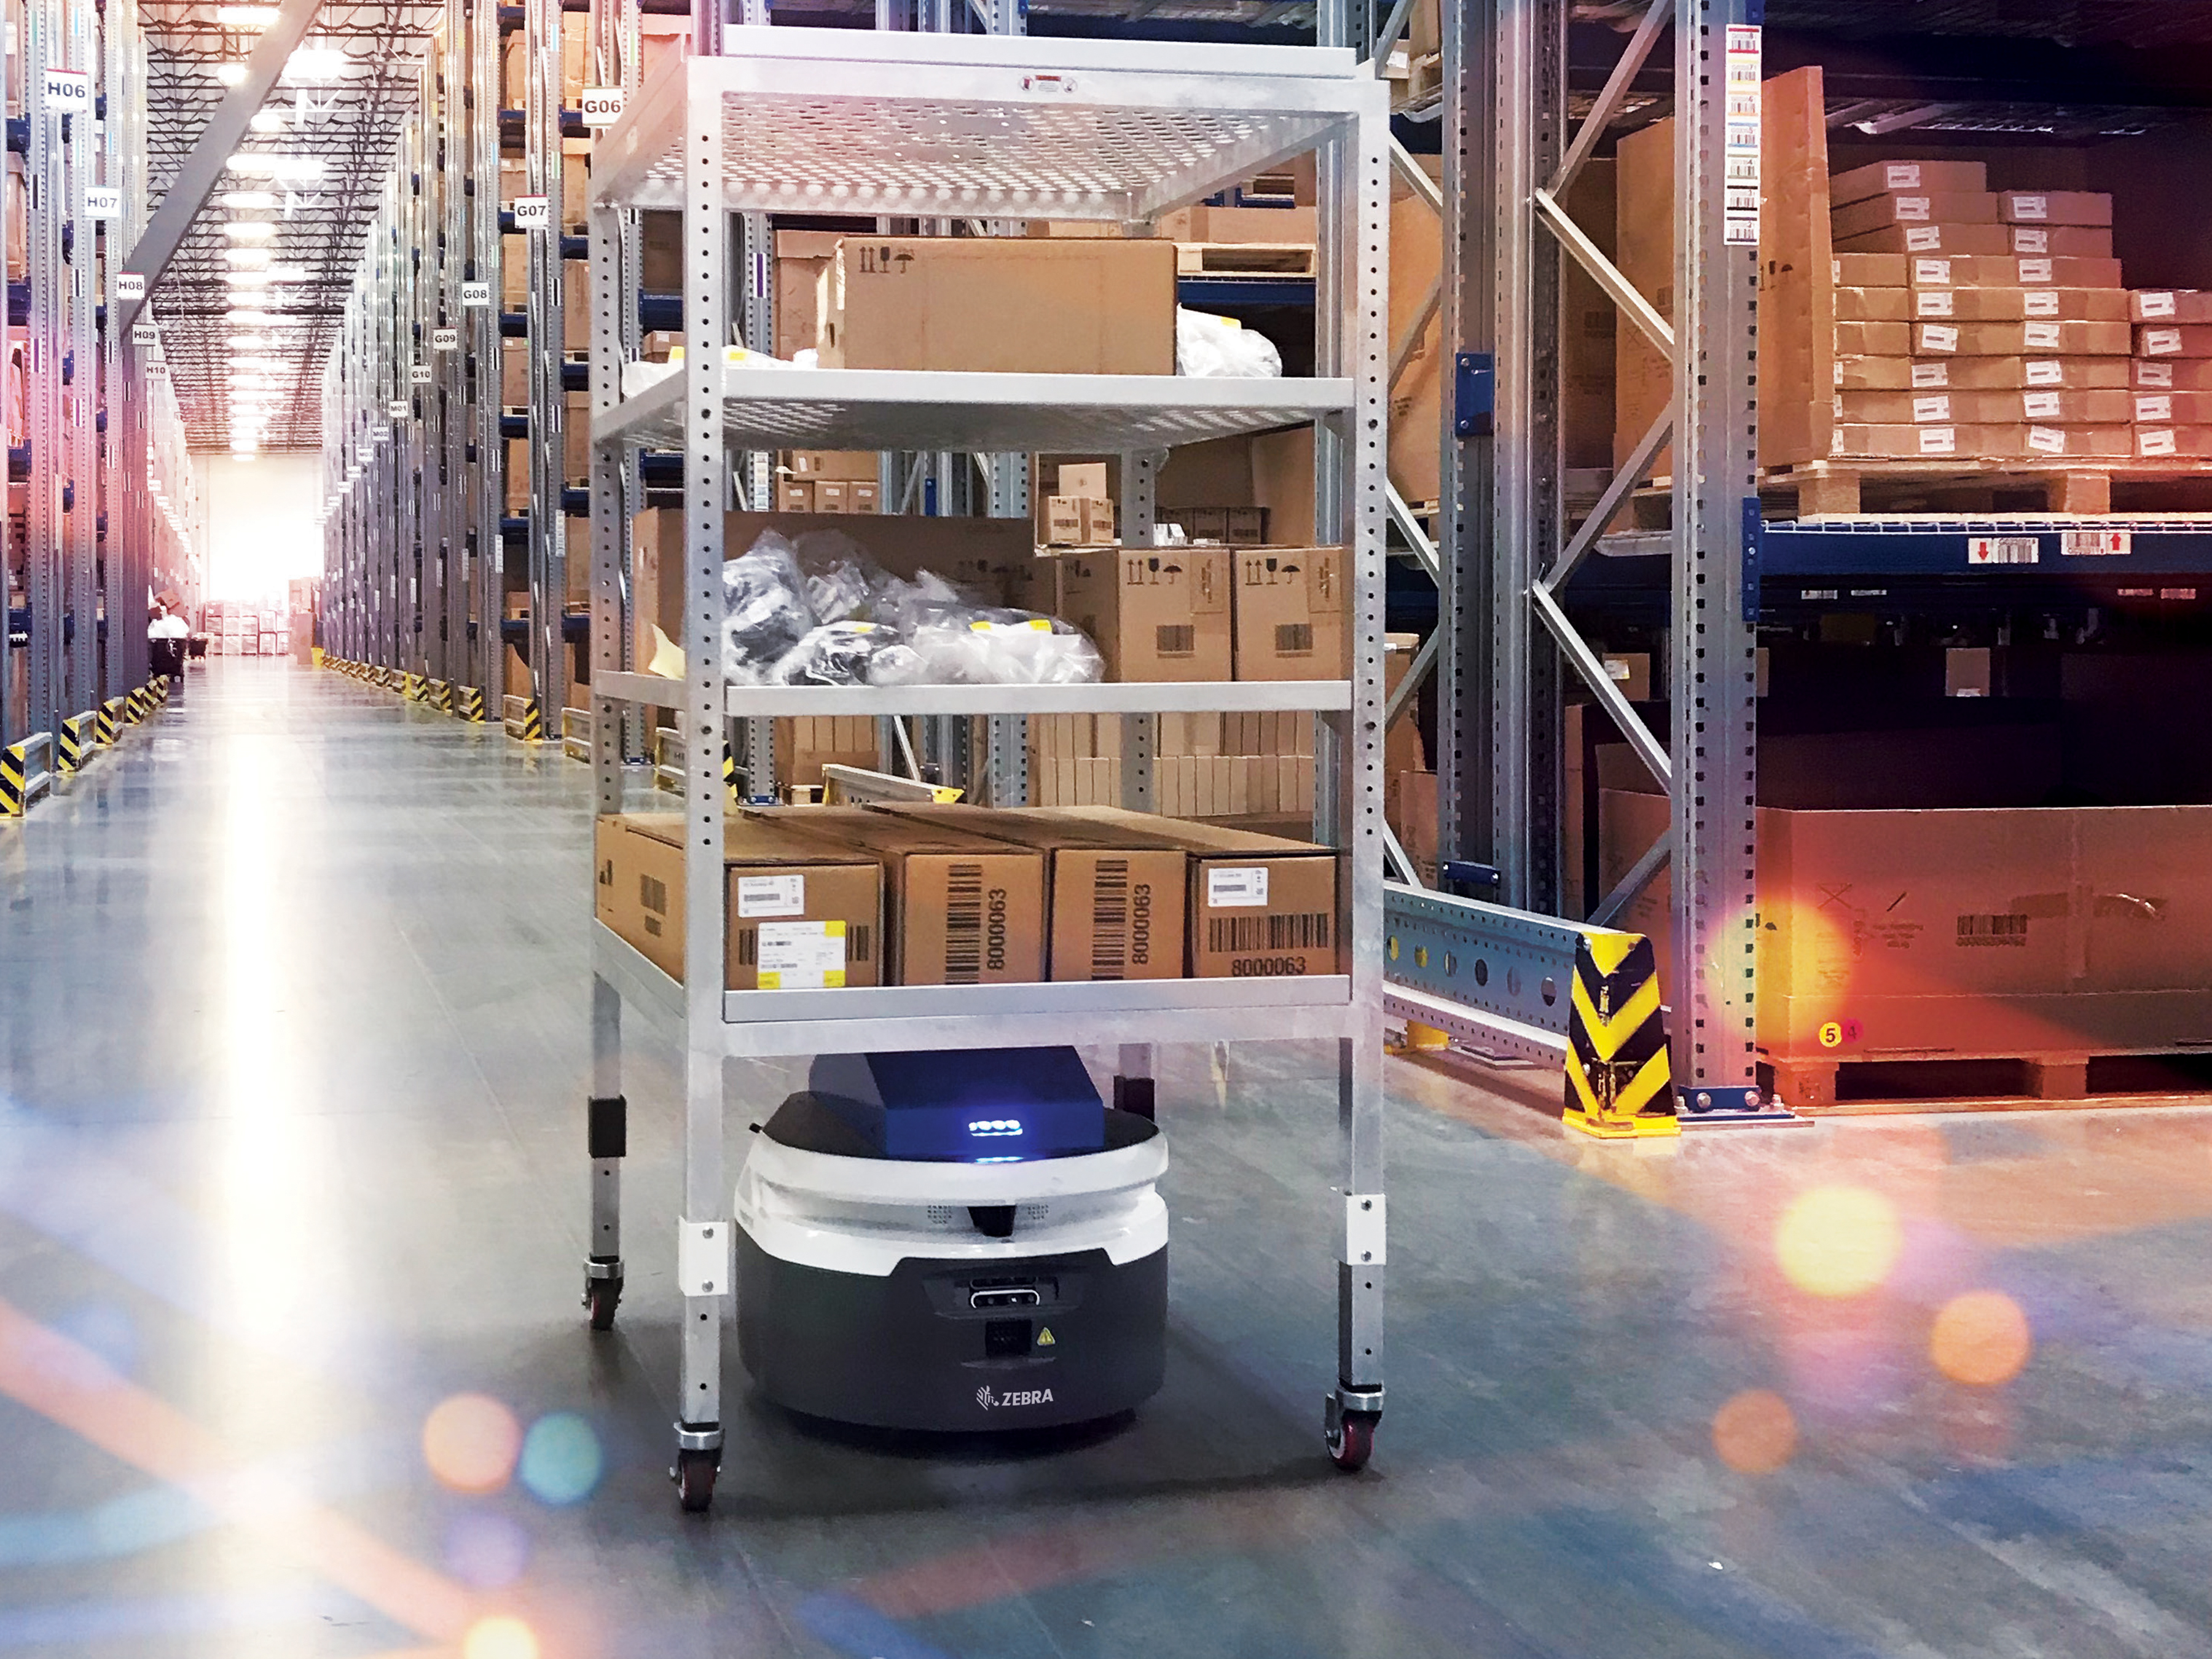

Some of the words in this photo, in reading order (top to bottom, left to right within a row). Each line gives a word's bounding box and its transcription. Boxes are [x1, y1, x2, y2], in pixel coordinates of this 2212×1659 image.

[48, 82, 85, 98] H06
[584, 100, 621, 113] G06
[87, 197, 117, 208] H07
[517, 205, 546, 216] G07
[119, 281, 143, 290] H08
[464, 290, 487, 299] G08
[134, 331, 155, 339] H09
[435, 334, 456, 343] G09
[987, 888, 1006, 970] 8000063
[1132, 884, 1150, 965] 8000063
[1231, 956, 1306, 977] 8000063
[1826, 1027, 1836, 1043] 5
[1002, 1388, 1054, 1406] ZEBRA
